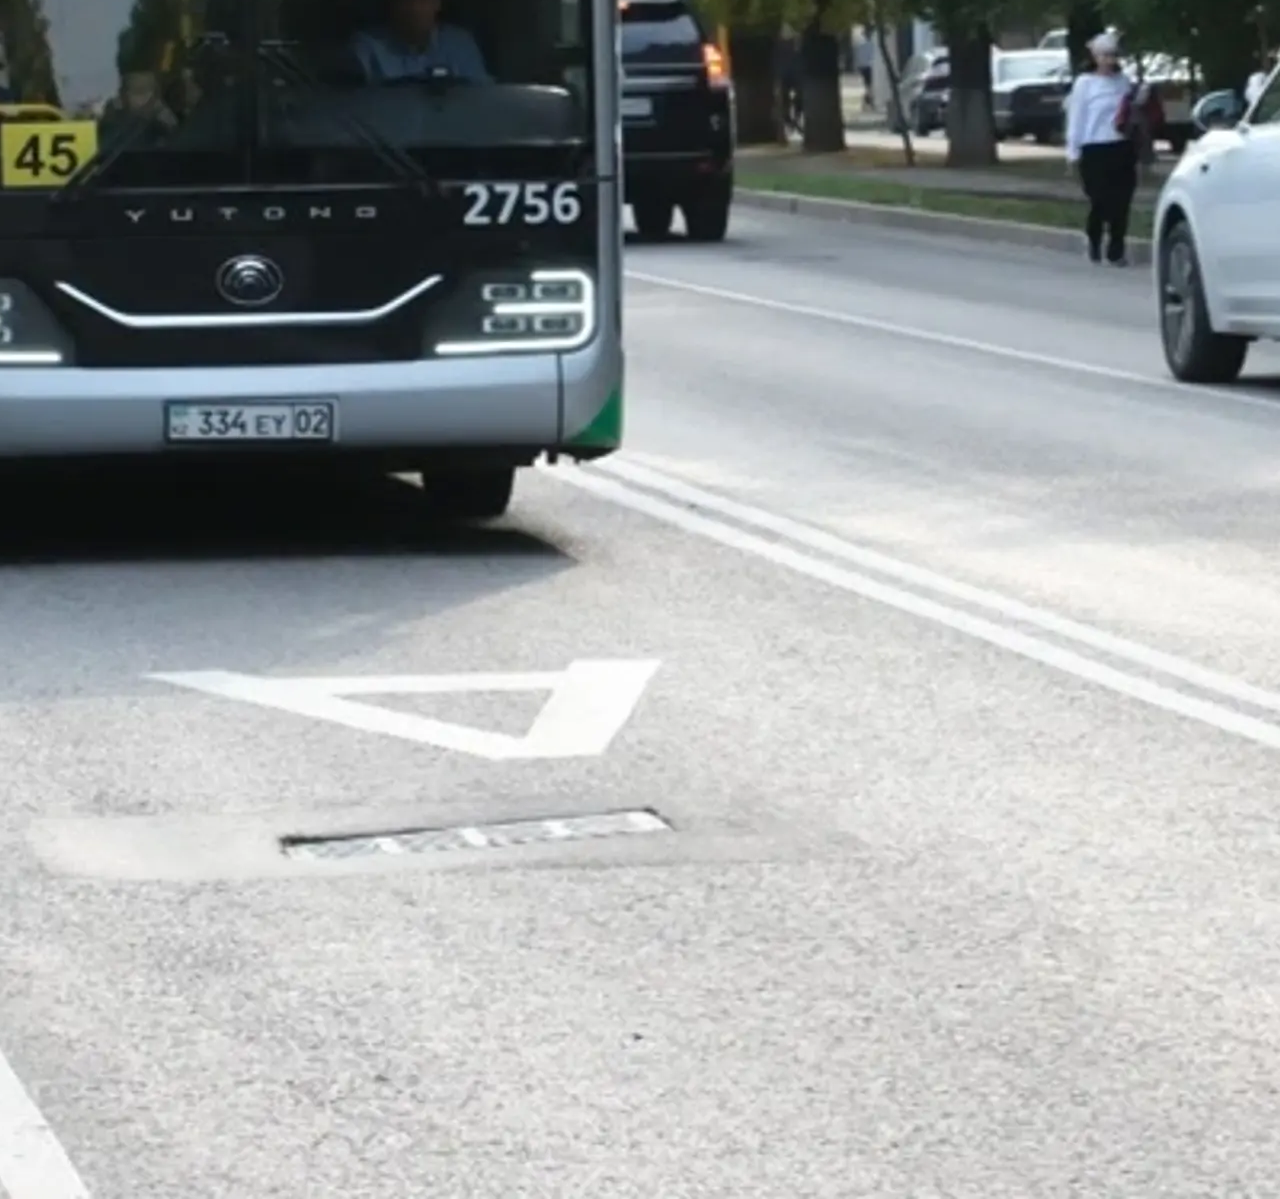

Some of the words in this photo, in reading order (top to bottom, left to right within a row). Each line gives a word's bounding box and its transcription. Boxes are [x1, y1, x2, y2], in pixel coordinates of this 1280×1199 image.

[14, 133, 78, 177] 45
[124, 206, 377, 223] YUTONG
[463, 182, 581, 224] 2756
[198, 409, 247, 435] 334
[255, 414, 286, 435] EY
[295, 408, 329, 434] 02
